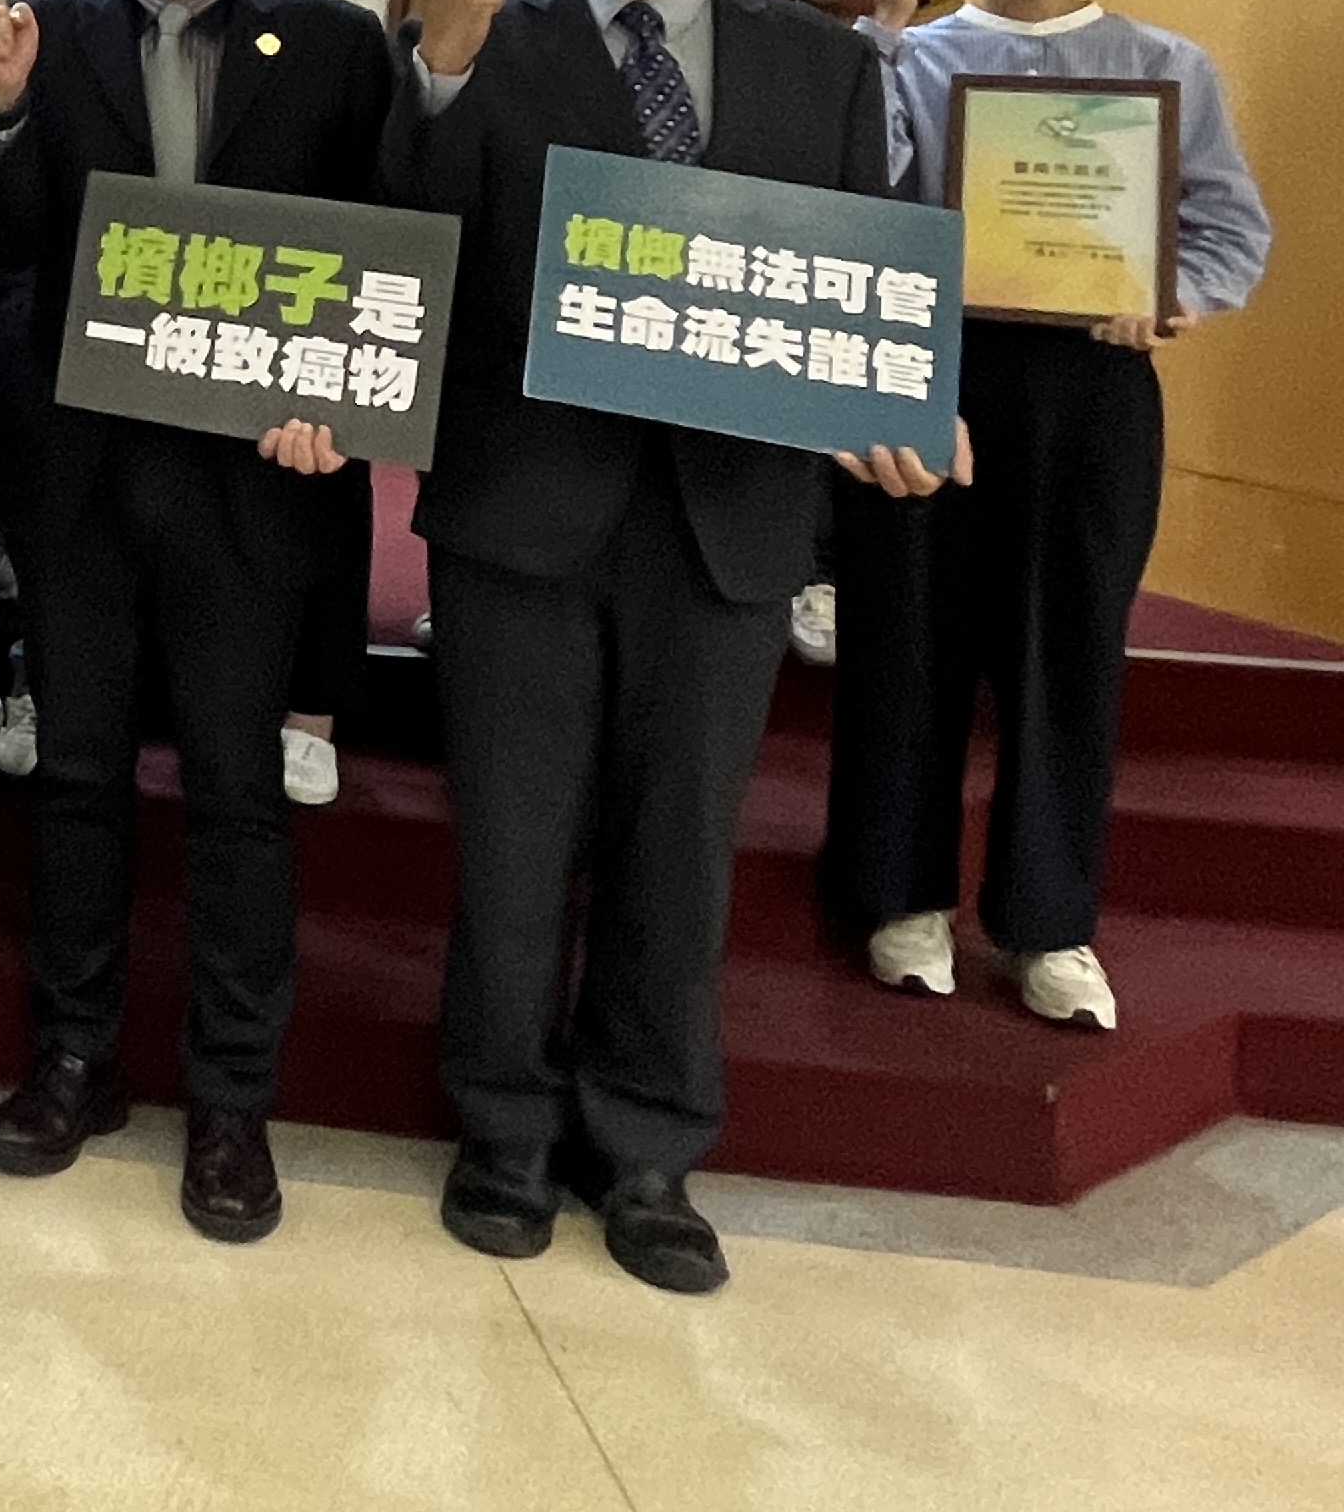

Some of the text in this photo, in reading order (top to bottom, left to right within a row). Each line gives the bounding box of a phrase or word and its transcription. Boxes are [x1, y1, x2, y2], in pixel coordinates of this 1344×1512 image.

[96, 222, 425, 343] 檳榔子是
[564, 213, 938, 328] 檳榔無法可管
[85, 312, 419, 412] 一級致癌物
[556, 282, 934, 401] 生命流失誰管
